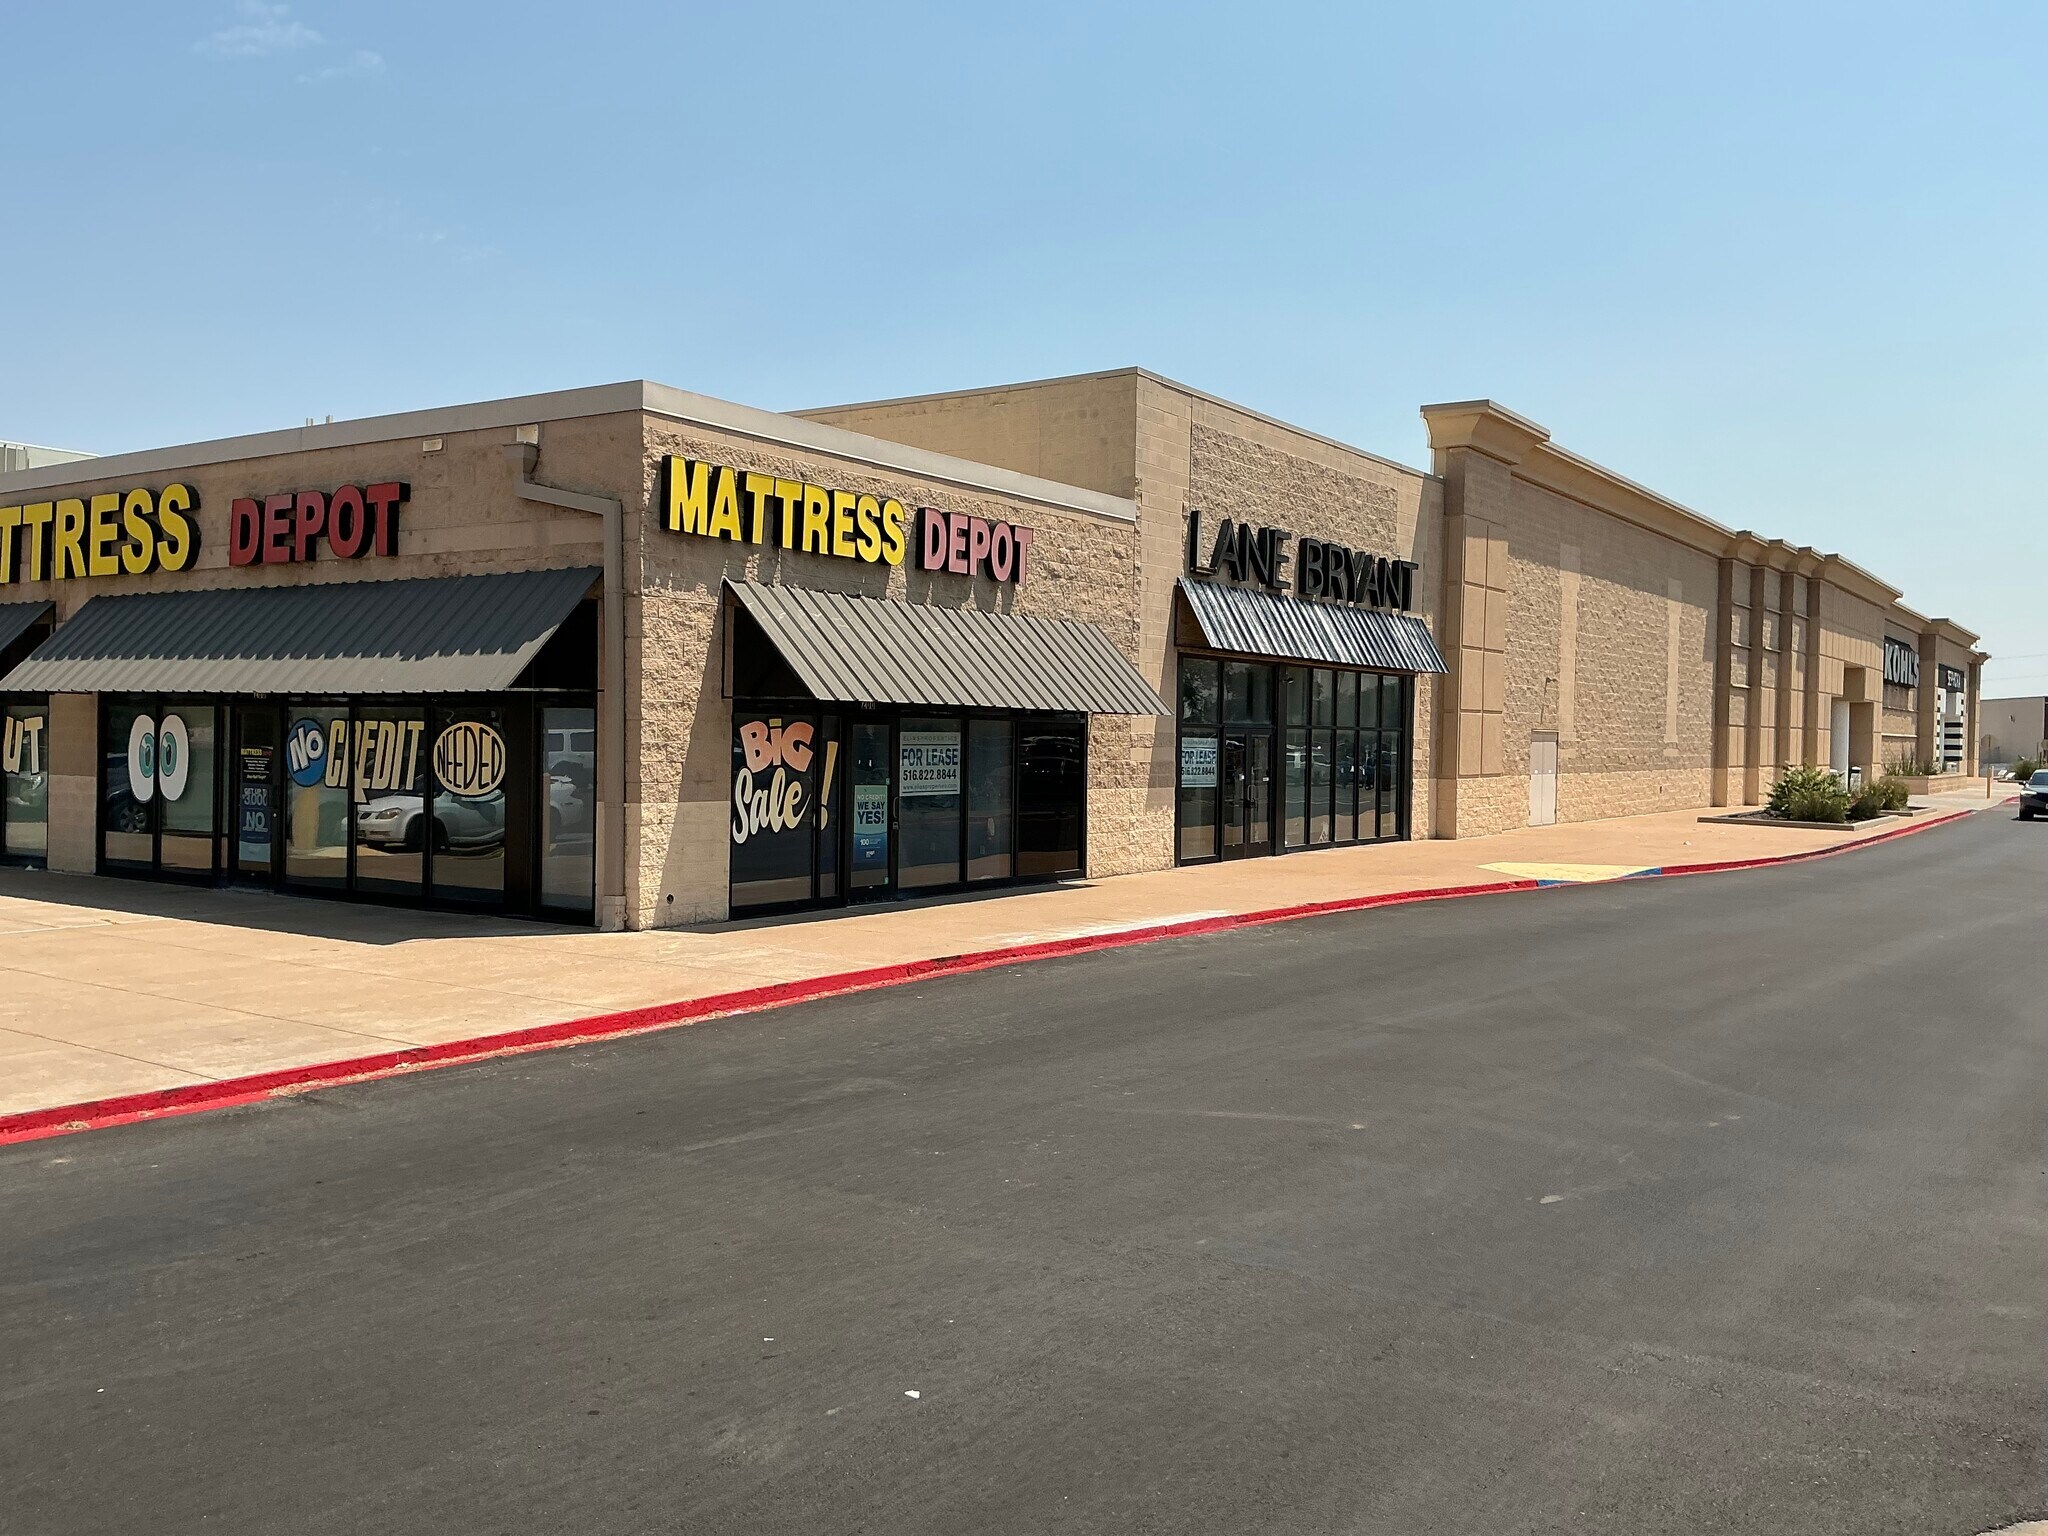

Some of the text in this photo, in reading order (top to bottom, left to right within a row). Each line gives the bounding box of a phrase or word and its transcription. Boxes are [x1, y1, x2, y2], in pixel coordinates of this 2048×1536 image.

[229, 482, 408, 566] DEPOT
[662, 455, 1034, 585] MATTRESS DEPOT
[1189, 510, 1419, 612] LANE BRYANT
[1884, 643, 1920, 688] KOHL'S
[325, 720, 425, 803] CREDIT
[436, 725, 503, 790] NEEDED
[901, 748, 959, 766] FOR LEASE
[1181, 751, 1195, 764] FOR
[903, 769, 957, 781] 516.822.8844
[857, 802, 885, 810] WE SAY
[857, 811, 885, 824] YES!
